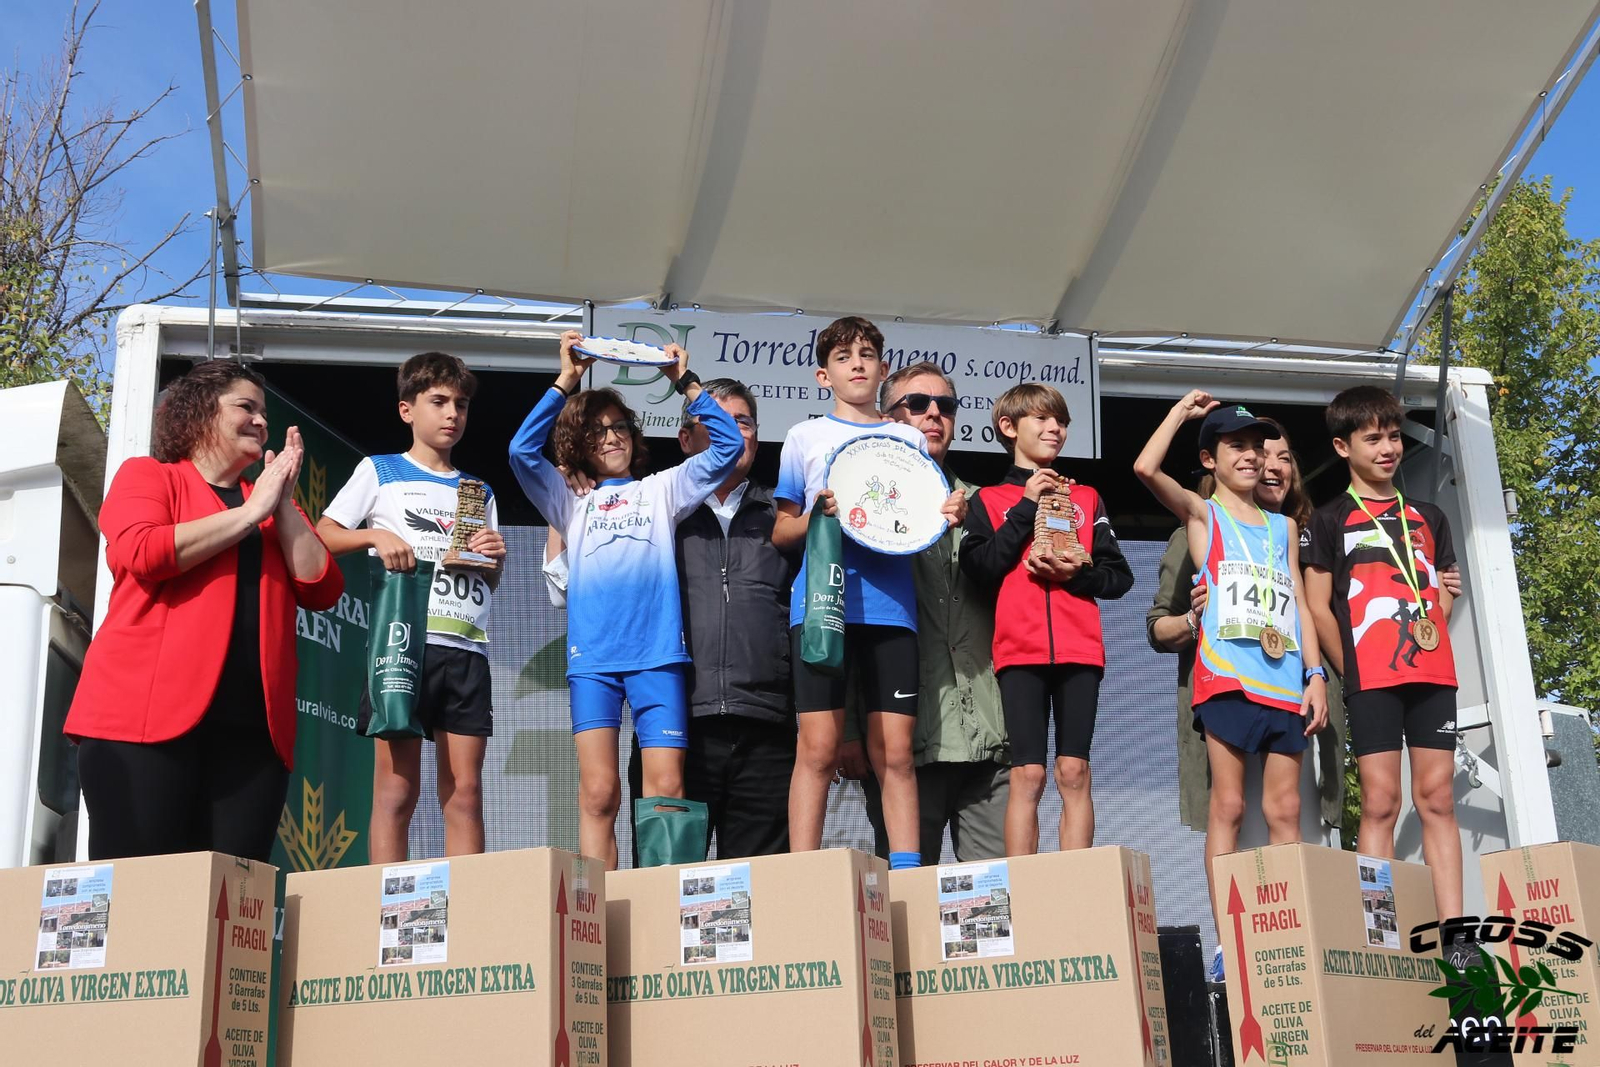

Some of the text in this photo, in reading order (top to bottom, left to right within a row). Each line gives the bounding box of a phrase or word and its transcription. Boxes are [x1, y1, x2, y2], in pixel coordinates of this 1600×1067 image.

[984, 360, 1035, 384] coop.
[1040, 356, 1085, 385] and.
[738, 380, 809, 400] CEITE
[439, 599, 462, 608] MARIO
[813, 593, 834, 602] Don
[1226, 581, 1290, 616] 1407
[296, 606, 341, 653] AEN
[375, 656, 393, 667] Don
[1256, 881, 1288, 905] MUY
[1526, 878, 1559, 901] MUY
[239, 897, 264, 920] MUY
[576, 890, 596, 914] MUY
[1252, 908, 1301, 933] FRAGIL
[1523, 904, 1574, 928] FRAGIL
[232, 925, 267, 951] FRAGIL
[571, 919, 602, 944] FRAGIL
[1255, 946, 1305, 963] CONTIENE
[571, 961, 603, 977] CONTIENE
[1257, 960, 1306, 975] 3 Garrafas
[1323, 949, 1441, 981] ACEITE DE OLIVA VIRGEN EXTRA
[1561, 967, 1578, 979] Lts.
[229, 968, 267, 984] CONTIENE
[607, 960, 841, 1002] EITE DE OLIVA VIRGEN EXTRA
[917, 969, 938, 994] DE
[941, 965, 990, 993] OLIVA
[992, 960, 1057, 988] VIRGEN
[1060, 954, 1118, 982] EXTRA
[1264, 974, 1303, 988] de 5 Lts.
[20, 976, 65, 1004] OLIVA
[71, 972, 131, 1001] VIRGEN
[134, 968, 189, 997] EXTRA
[228, 983, 265, 998] 3 Garrafas
[289, 963, 535, 1006] ACEITE DE OLIVA VIRGEN EXTRA
[571, 976, 603, 991] 3 Garrafas
[232, 999, 261, 1013] de 5 Lts.
[575, 991, 600, 1005] de 5 Lts.
[1537, 993, 1590, 1007] ACEITE DE
[1261, 1001, 1312, 1017] ACEITE DE
[1549, 1007, 1581, 1020] OLIVA
[572, 1021, 603, 1034] ACEITE DE
[1273, 1016, 1303, 1029] OLIVA
[225, 1028, 263, 1043] ACEITE DE
[578, 1036, 597, 1049] OLIVA
[1271, 1029, 1309, 1043] VIRGEN
[232, 1044, 254, 1057] OLIVA
[1275, 1044, 1308, 1057] EXTRA
[1019, 1057, 1026, 1065] Y
[1028, 1057, 1042, 1065] DE
[1045, 1056, 1057, 1064] LA
[1060, 1054, 1079, 1064] LUZ
